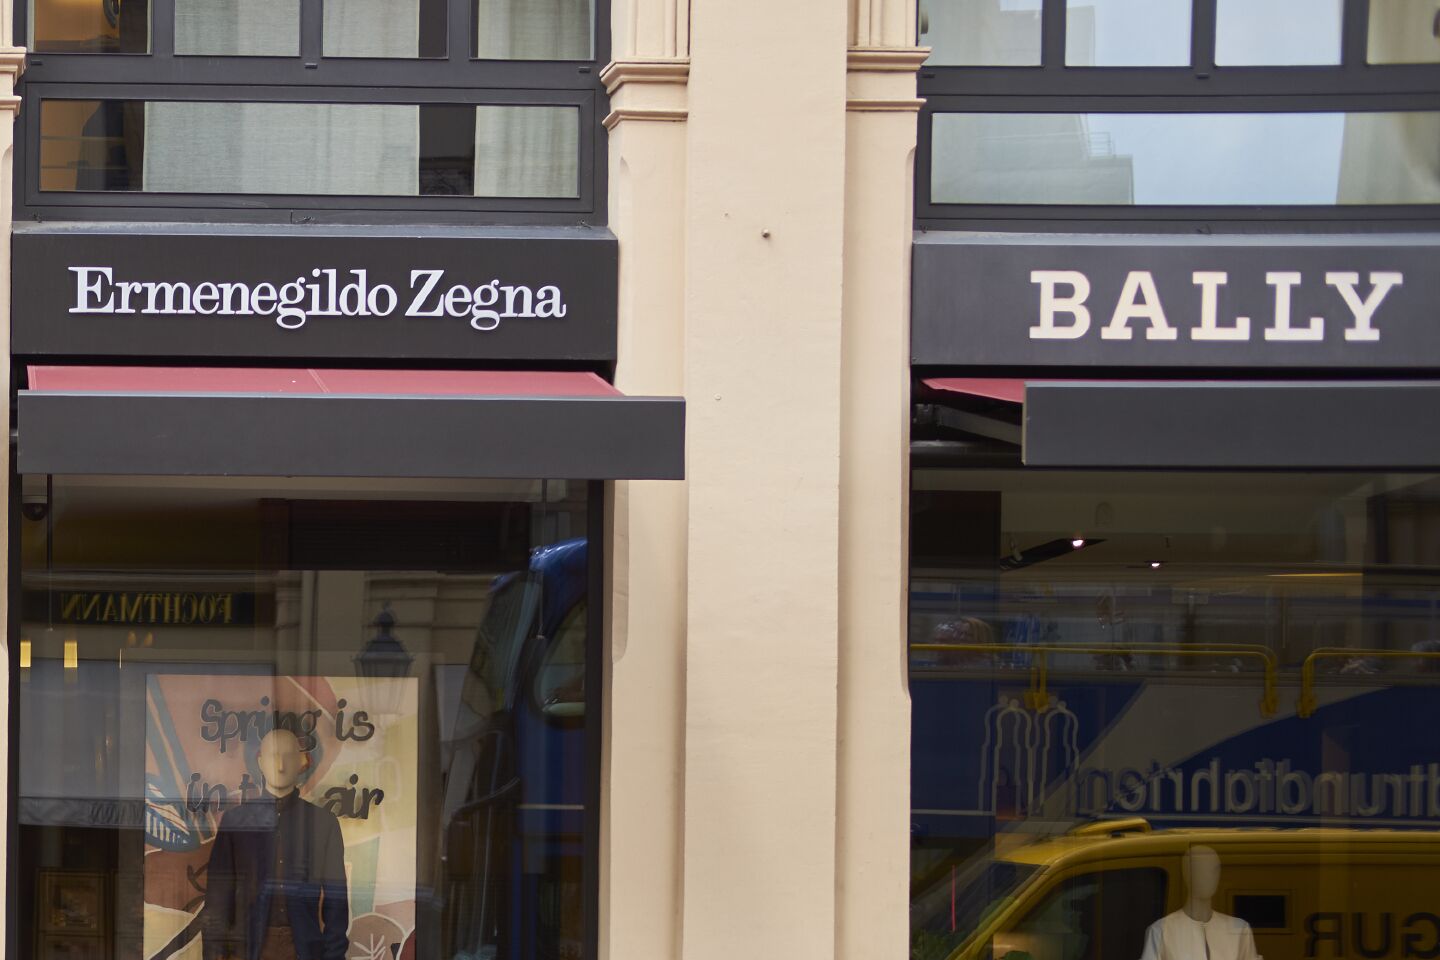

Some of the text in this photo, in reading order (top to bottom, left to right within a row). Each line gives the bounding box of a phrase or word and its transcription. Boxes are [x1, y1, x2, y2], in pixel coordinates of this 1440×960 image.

[67, 265, 567, 331] Ermenegildo Zegna
[1028, 270, 1404, 342] BALLY
[200, 696, 376, 754] Spring is
[324, 774, 385, 820] air
